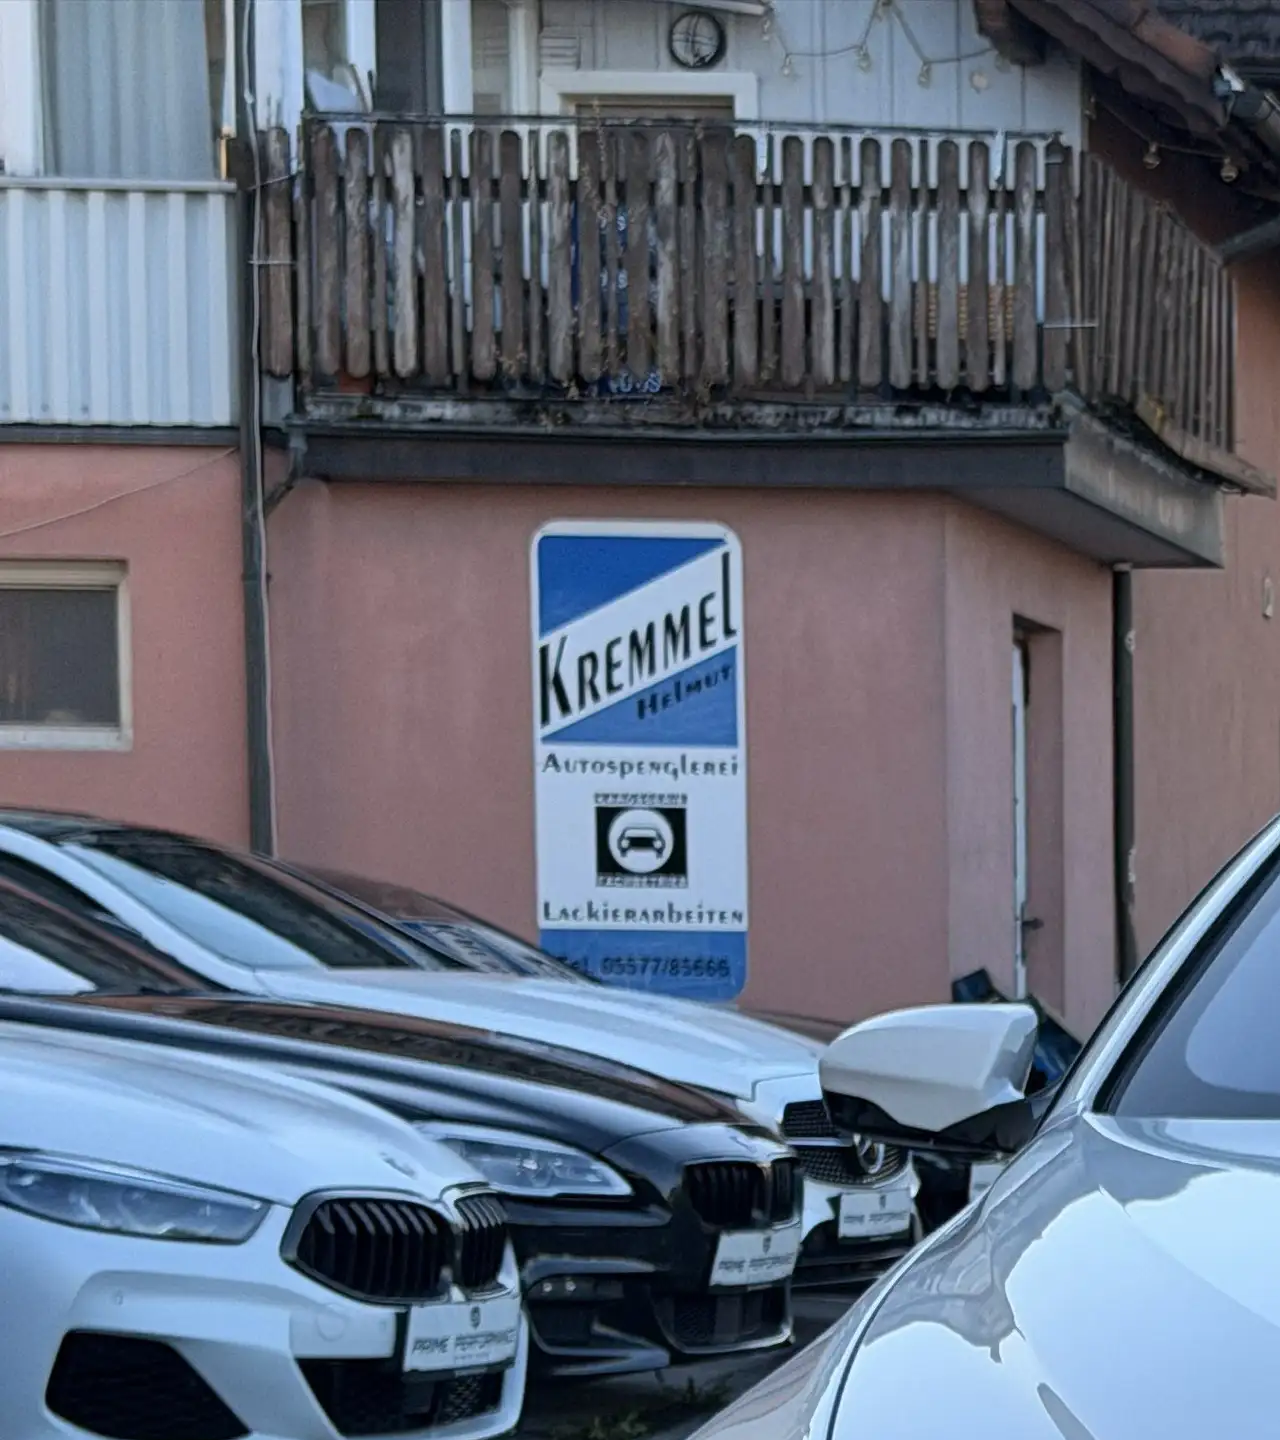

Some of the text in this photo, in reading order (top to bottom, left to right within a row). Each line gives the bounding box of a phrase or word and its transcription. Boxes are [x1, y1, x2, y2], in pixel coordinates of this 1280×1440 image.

[540, 551, 737, 729] KREMMEL
[541, 753, 738, 781] Autospenglerei
[543, 901, 743, 925] Lackierarbeiten
